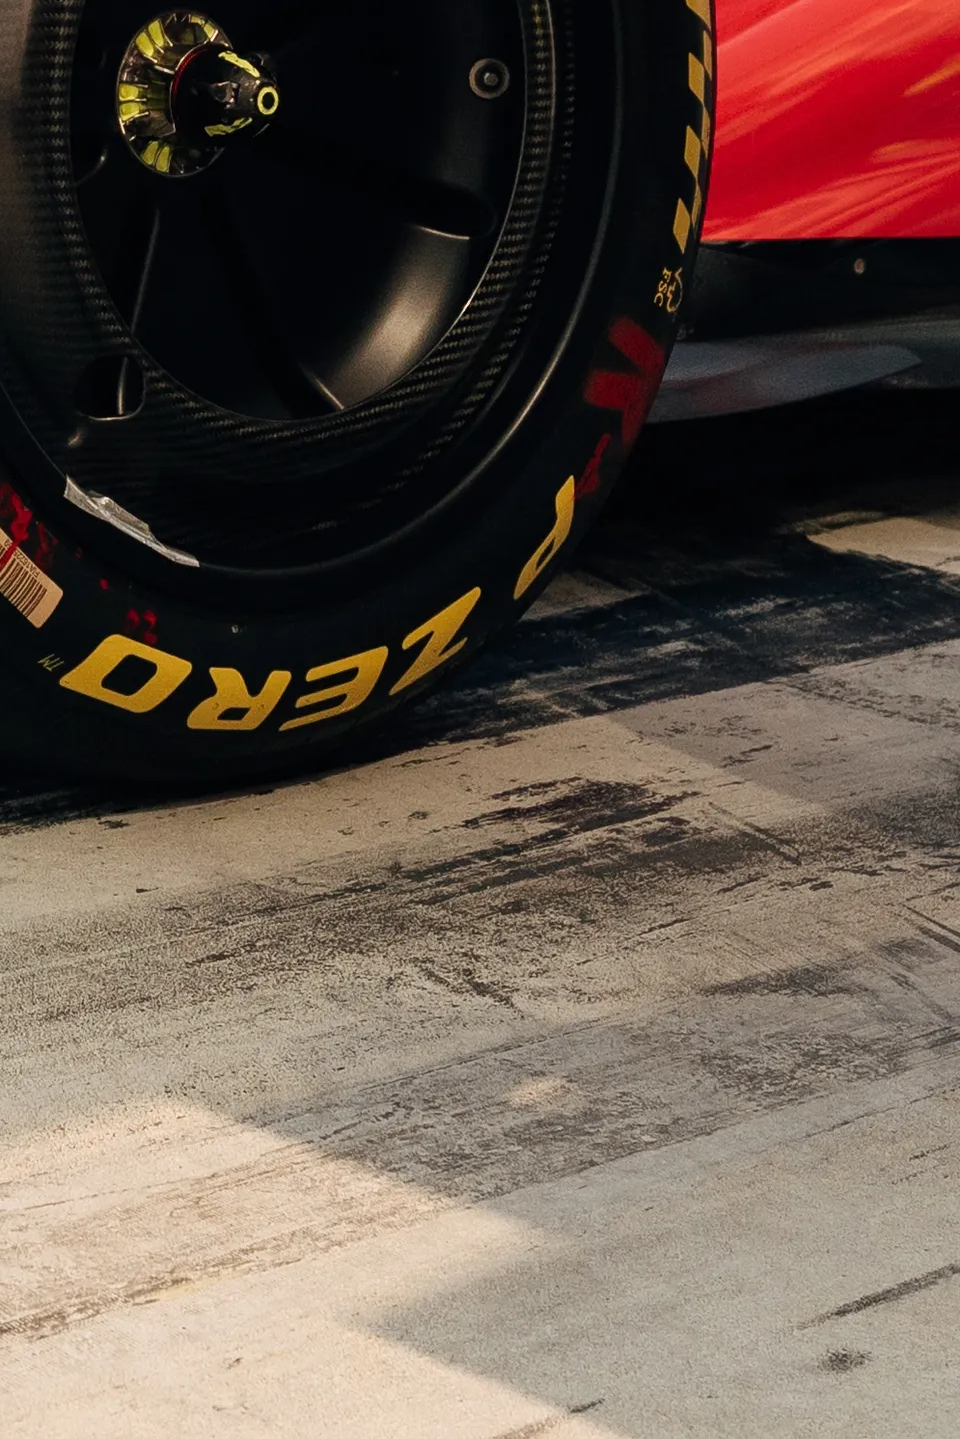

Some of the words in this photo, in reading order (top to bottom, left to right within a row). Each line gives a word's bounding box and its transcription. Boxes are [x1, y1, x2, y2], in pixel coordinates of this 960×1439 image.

[653, 267, 672, 307] FSC
[513, 474, 575, 601] P
[59, 586, 482, 732] ZERO
